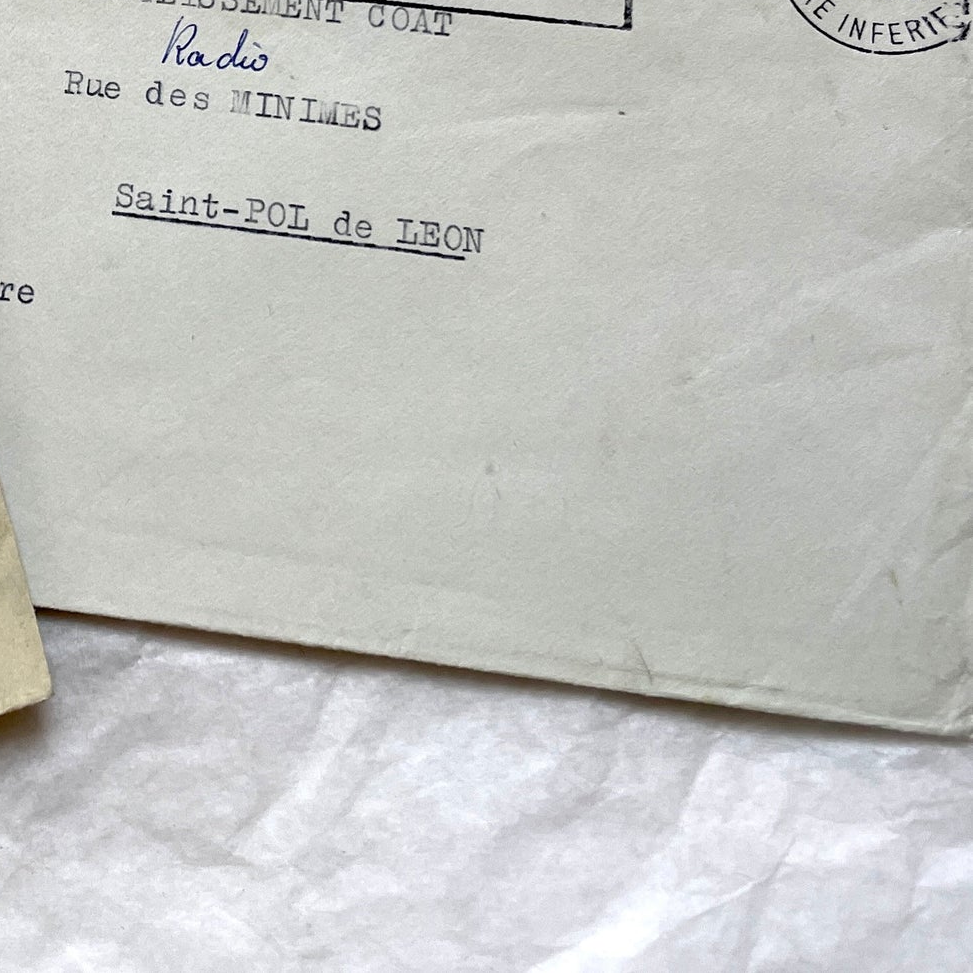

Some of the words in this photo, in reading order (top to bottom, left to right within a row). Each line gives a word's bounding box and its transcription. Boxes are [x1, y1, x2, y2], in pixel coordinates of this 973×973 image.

[367, 5, 454, 37] COAT
[63, 69, 122, 102] Rue
[144, 80, 211, 112] des
[229, 87, 384, 133] MINIMES
[113, 182, 311, 233] Saint-POL
[332, 210, 373, 240] de
[395, 217, 486, 256] LEON
